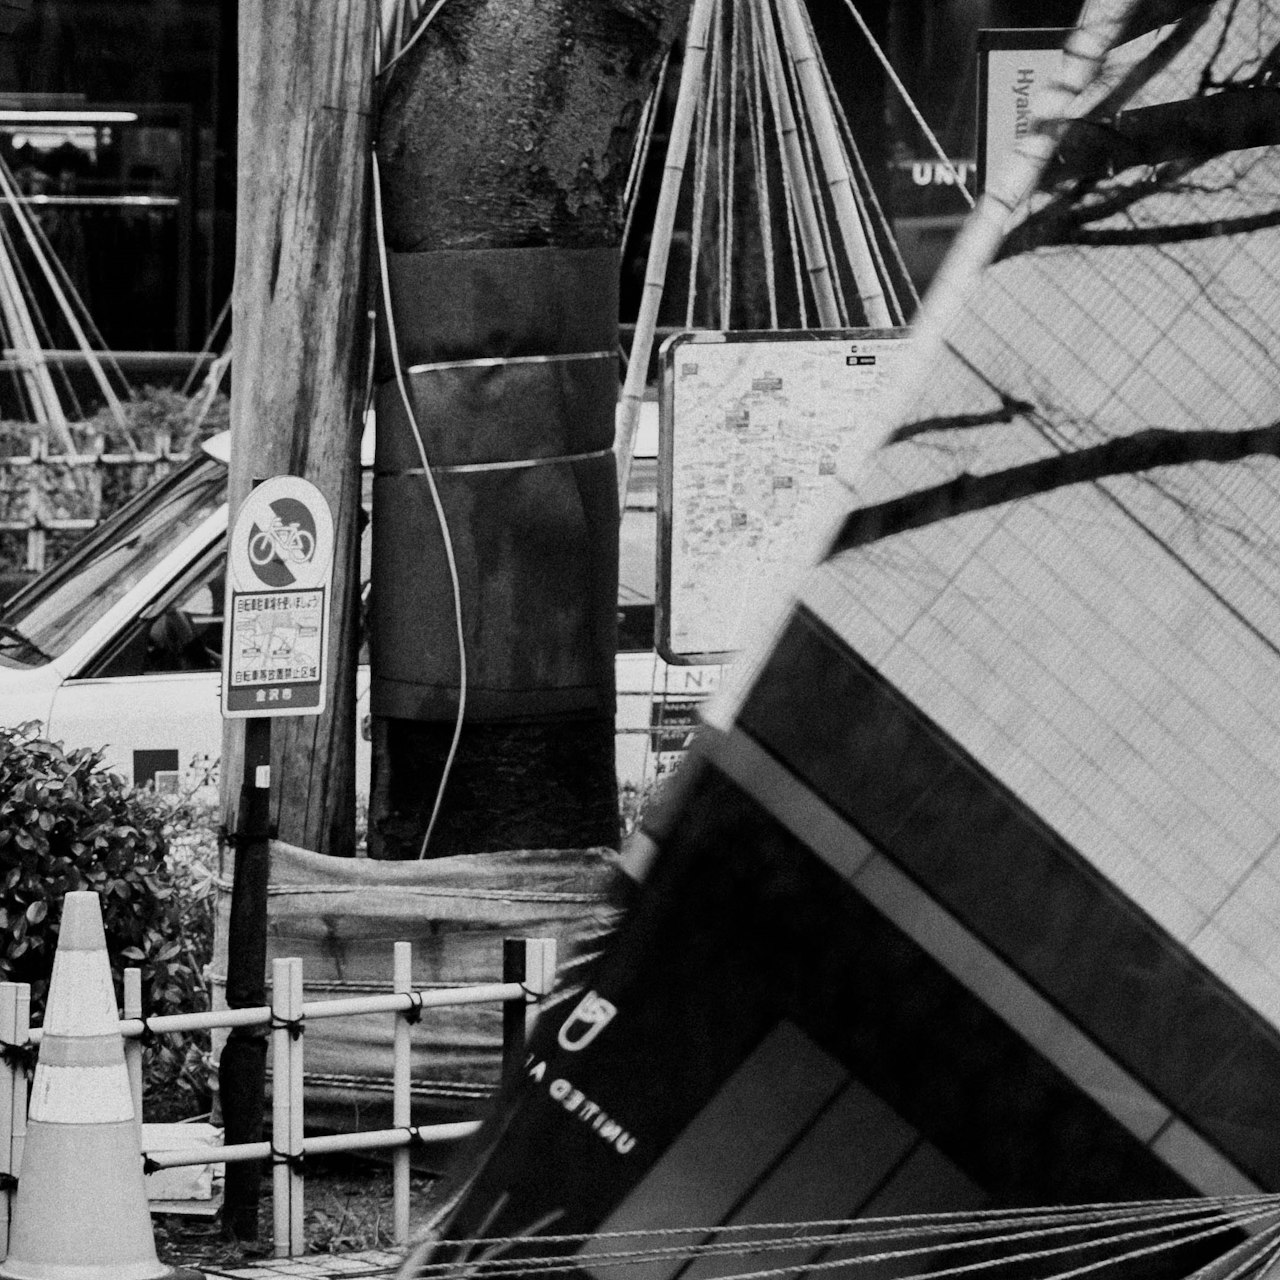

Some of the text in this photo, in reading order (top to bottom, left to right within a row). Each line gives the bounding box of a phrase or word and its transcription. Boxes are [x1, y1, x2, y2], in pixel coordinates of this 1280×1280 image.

[235, 666, 317, 683] 自転車等放置禁止区域
[255, 688, 292, 702] 金沢市
